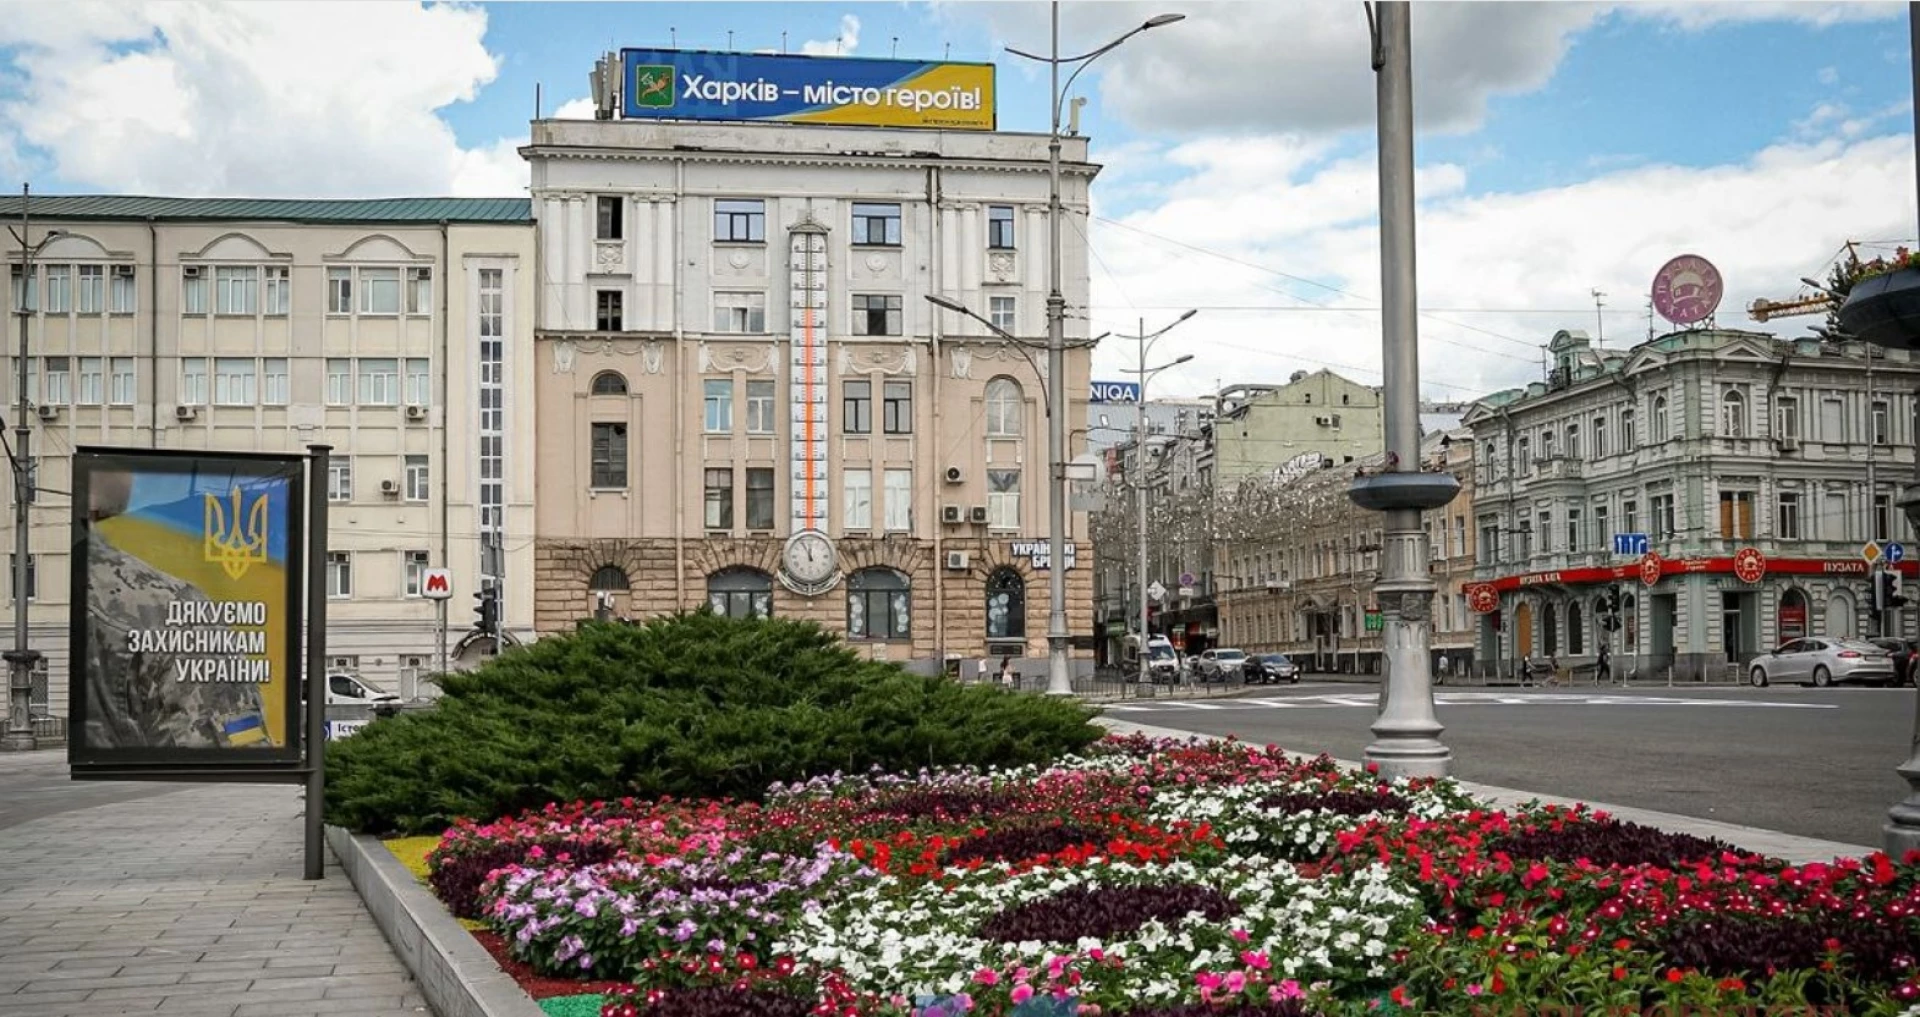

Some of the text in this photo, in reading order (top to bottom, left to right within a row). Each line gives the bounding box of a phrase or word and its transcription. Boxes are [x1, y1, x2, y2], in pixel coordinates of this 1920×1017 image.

[682, 74, 779, 105] Харків
[803, 80, 881, 106] місто
[886, 86, 981, 112] героїв!
[1090, 383, 1136, 401] NIQA
[1011, 540, 1076, 556] УКРАЇНКІ
[1823, 561, 1865, 573] ПУЗАТА
[165, 600, 267, 626] ДЯКУЄМО
[127, 629, 266, 653] ЗАХИСНИКАМ
[174, 655, 271, 683] УКРАЇНИ!
